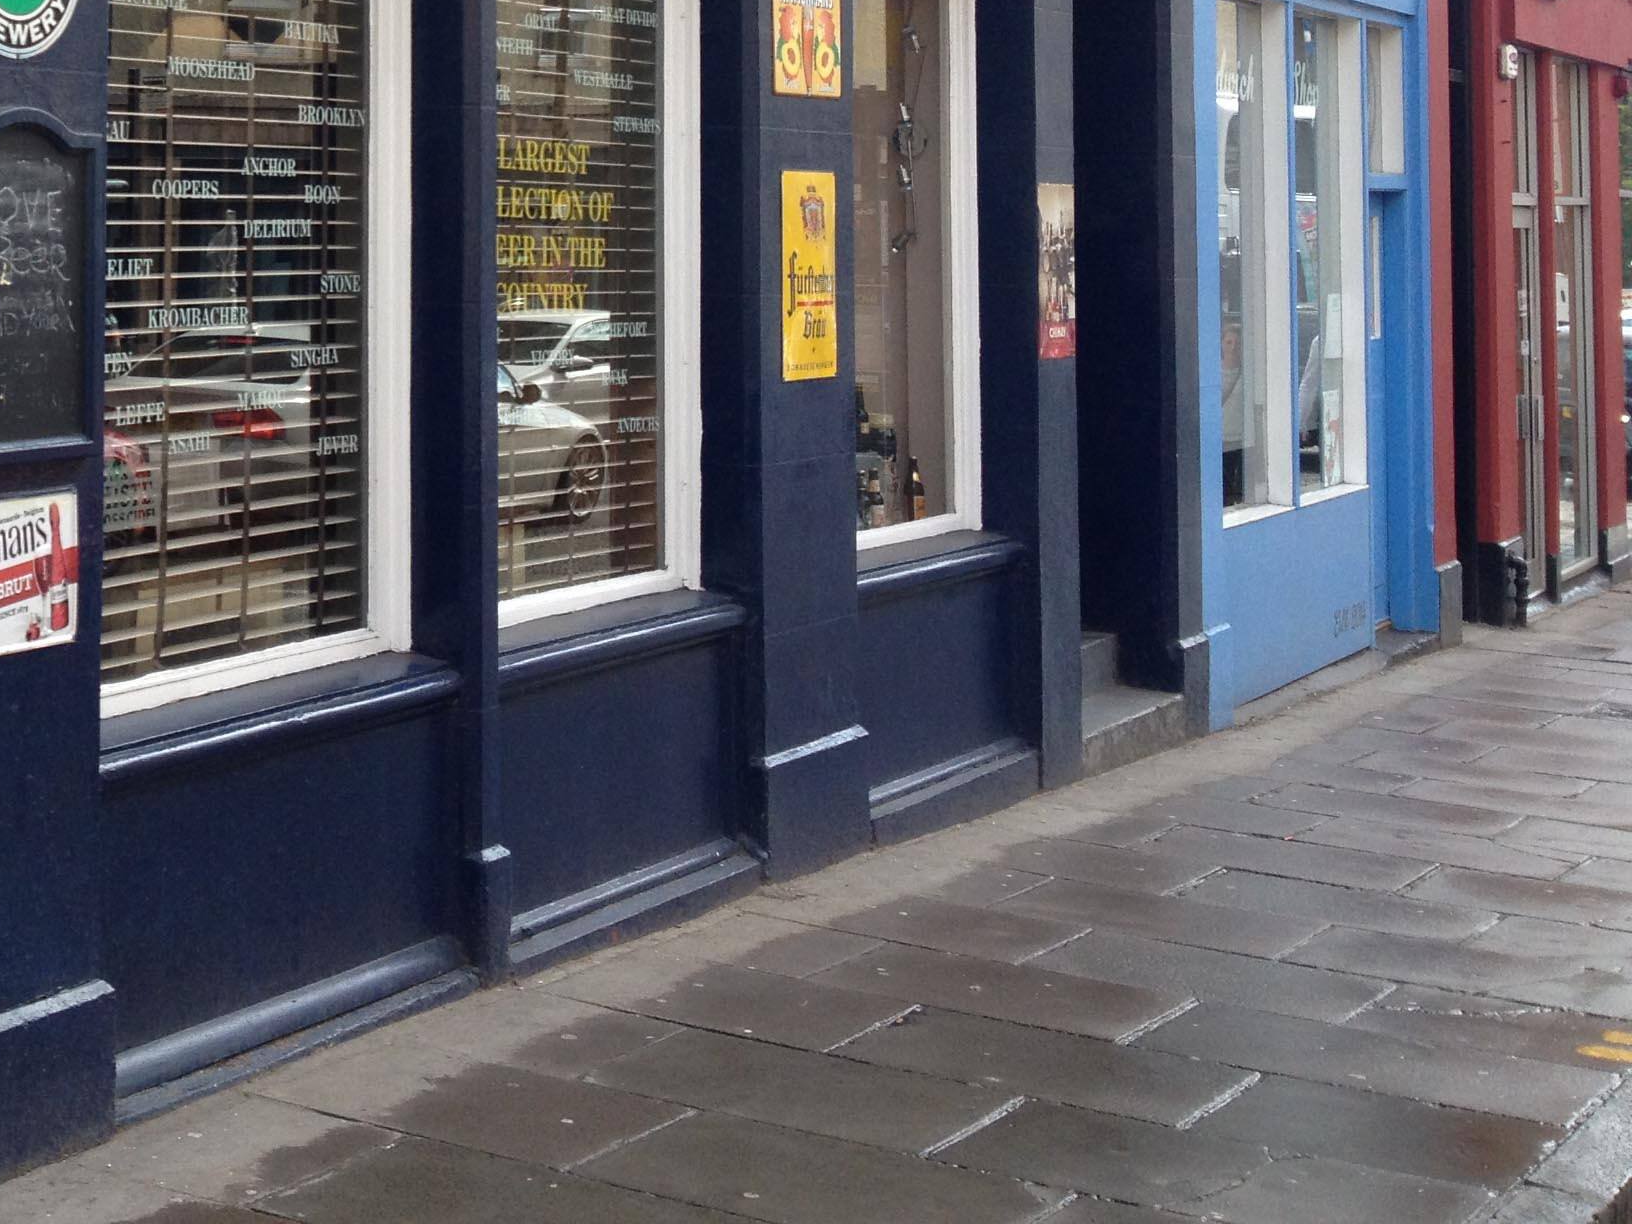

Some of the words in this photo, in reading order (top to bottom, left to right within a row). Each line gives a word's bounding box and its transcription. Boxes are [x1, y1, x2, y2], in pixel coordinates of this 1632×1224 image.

[284, 20, 340, 45] BALTIKA
[524, 13, 561, 33] ORVAL
[168, 56, 256, 81] MOOSEHEAD
[574, 69, 634, 91] WESTMALLE
[298, 104, 366, 127] BROOKLYN
[613, 116, 661, 135] STEWARTS
[241, 156, 297, 177] ANCHOR
[498, 137, 591, 176] LARGEST
[152, 179, 219, 199] COOPERS
[304, 184, 341, 204] BOON
[497, 186, 584, 222] LECTION
[588, 192, 614, 223] OF
[243, 218, 312, 239] DELIRIUM
[542, 236, 563, 267] IN
[568, 237, 607, 268] THE
[320, 274, 361, 294] STONE
[497, 282, 588, 314] COUNTRY
[148, 306, 249, 328] KROMBACHER
[290, 346, 339, 368] SINGHA
[115, 402, 166, 426] LEFFE
[617, 416, 661, 434] ANDECHS
[168, 432, 211, 455] ASAHI
[316, 434, 359, 456] JEVER
